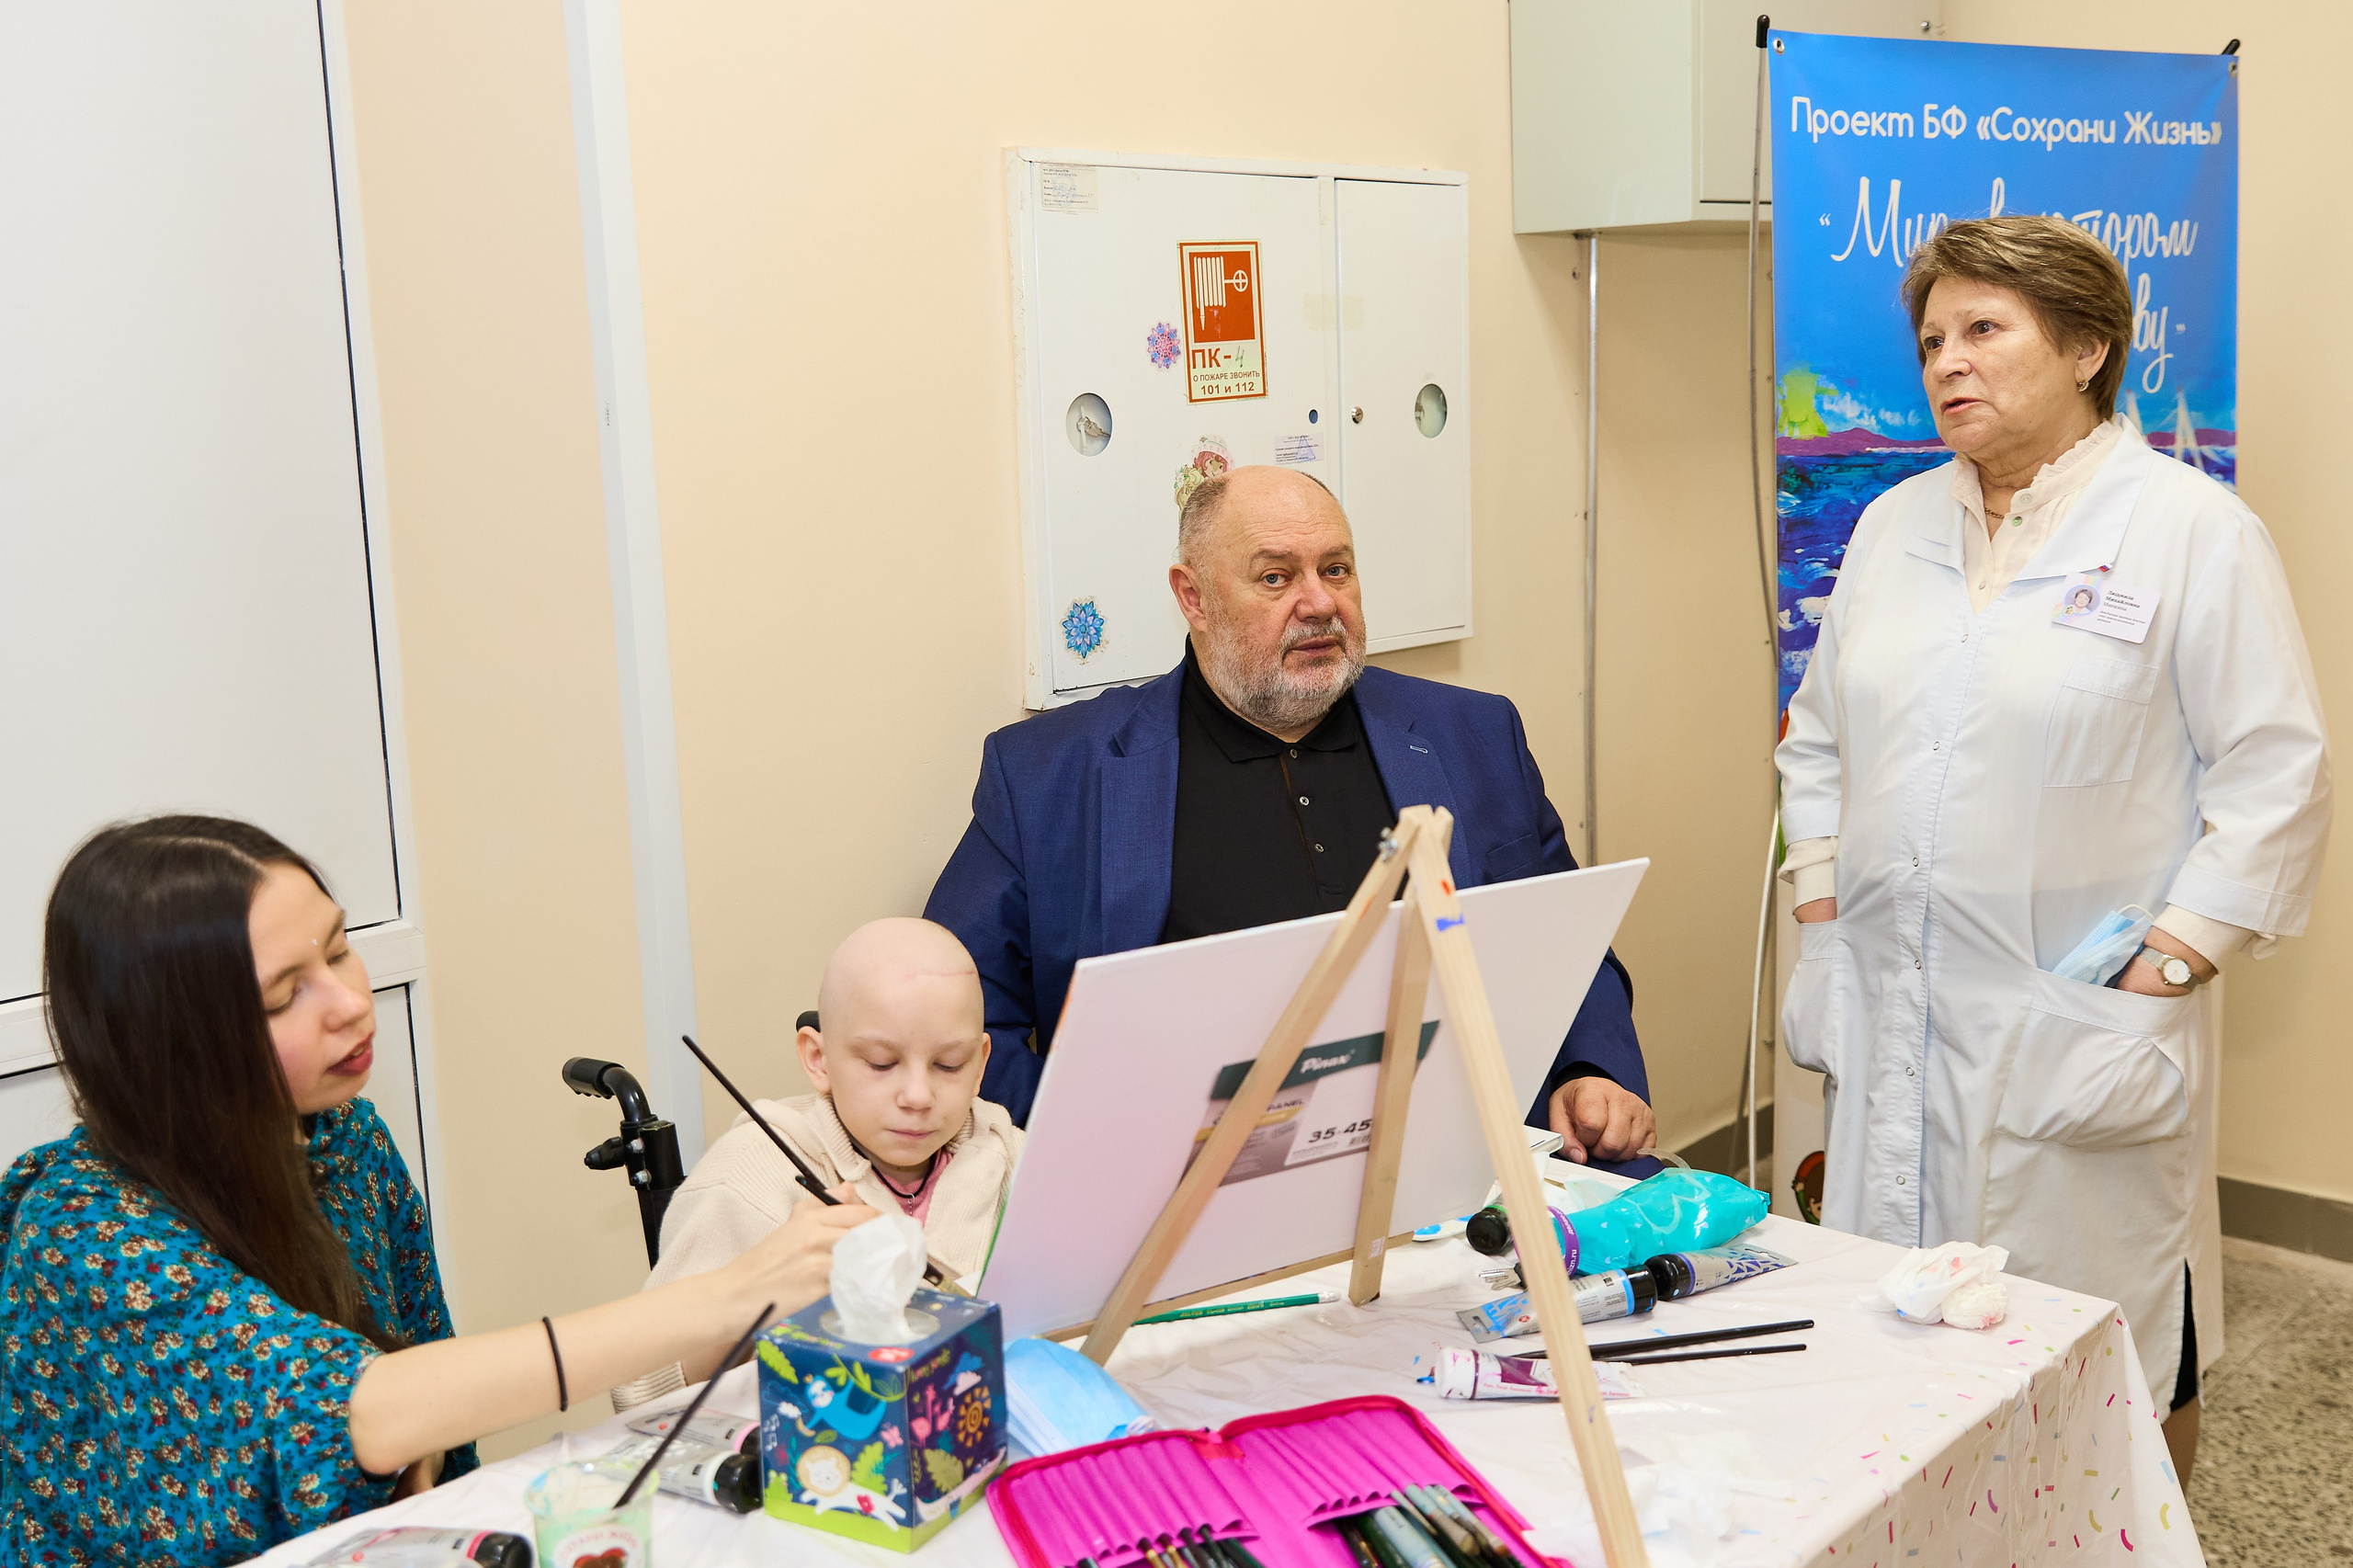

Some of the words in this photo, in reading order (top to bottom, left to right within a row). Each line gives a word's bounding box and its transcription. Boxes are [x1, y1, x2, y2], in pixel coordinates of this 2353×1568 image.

[1791, 96, 1915, 144] Проект
[1923, 103, 1967, 140] БФ
[1975, 106, 2117, 153] «Сохрани
[2122, 110, 2222, 145] Жизнь»
[1200, 373, 1228, 381] ПОЖАРЕ
[1230, 370, 1260, 380] ЗВОНИТЬ
[1200, 384, 1221, 395] 101
[1225, 385, 1232, 393] и
[1235, 381, 1255, 392] 112
